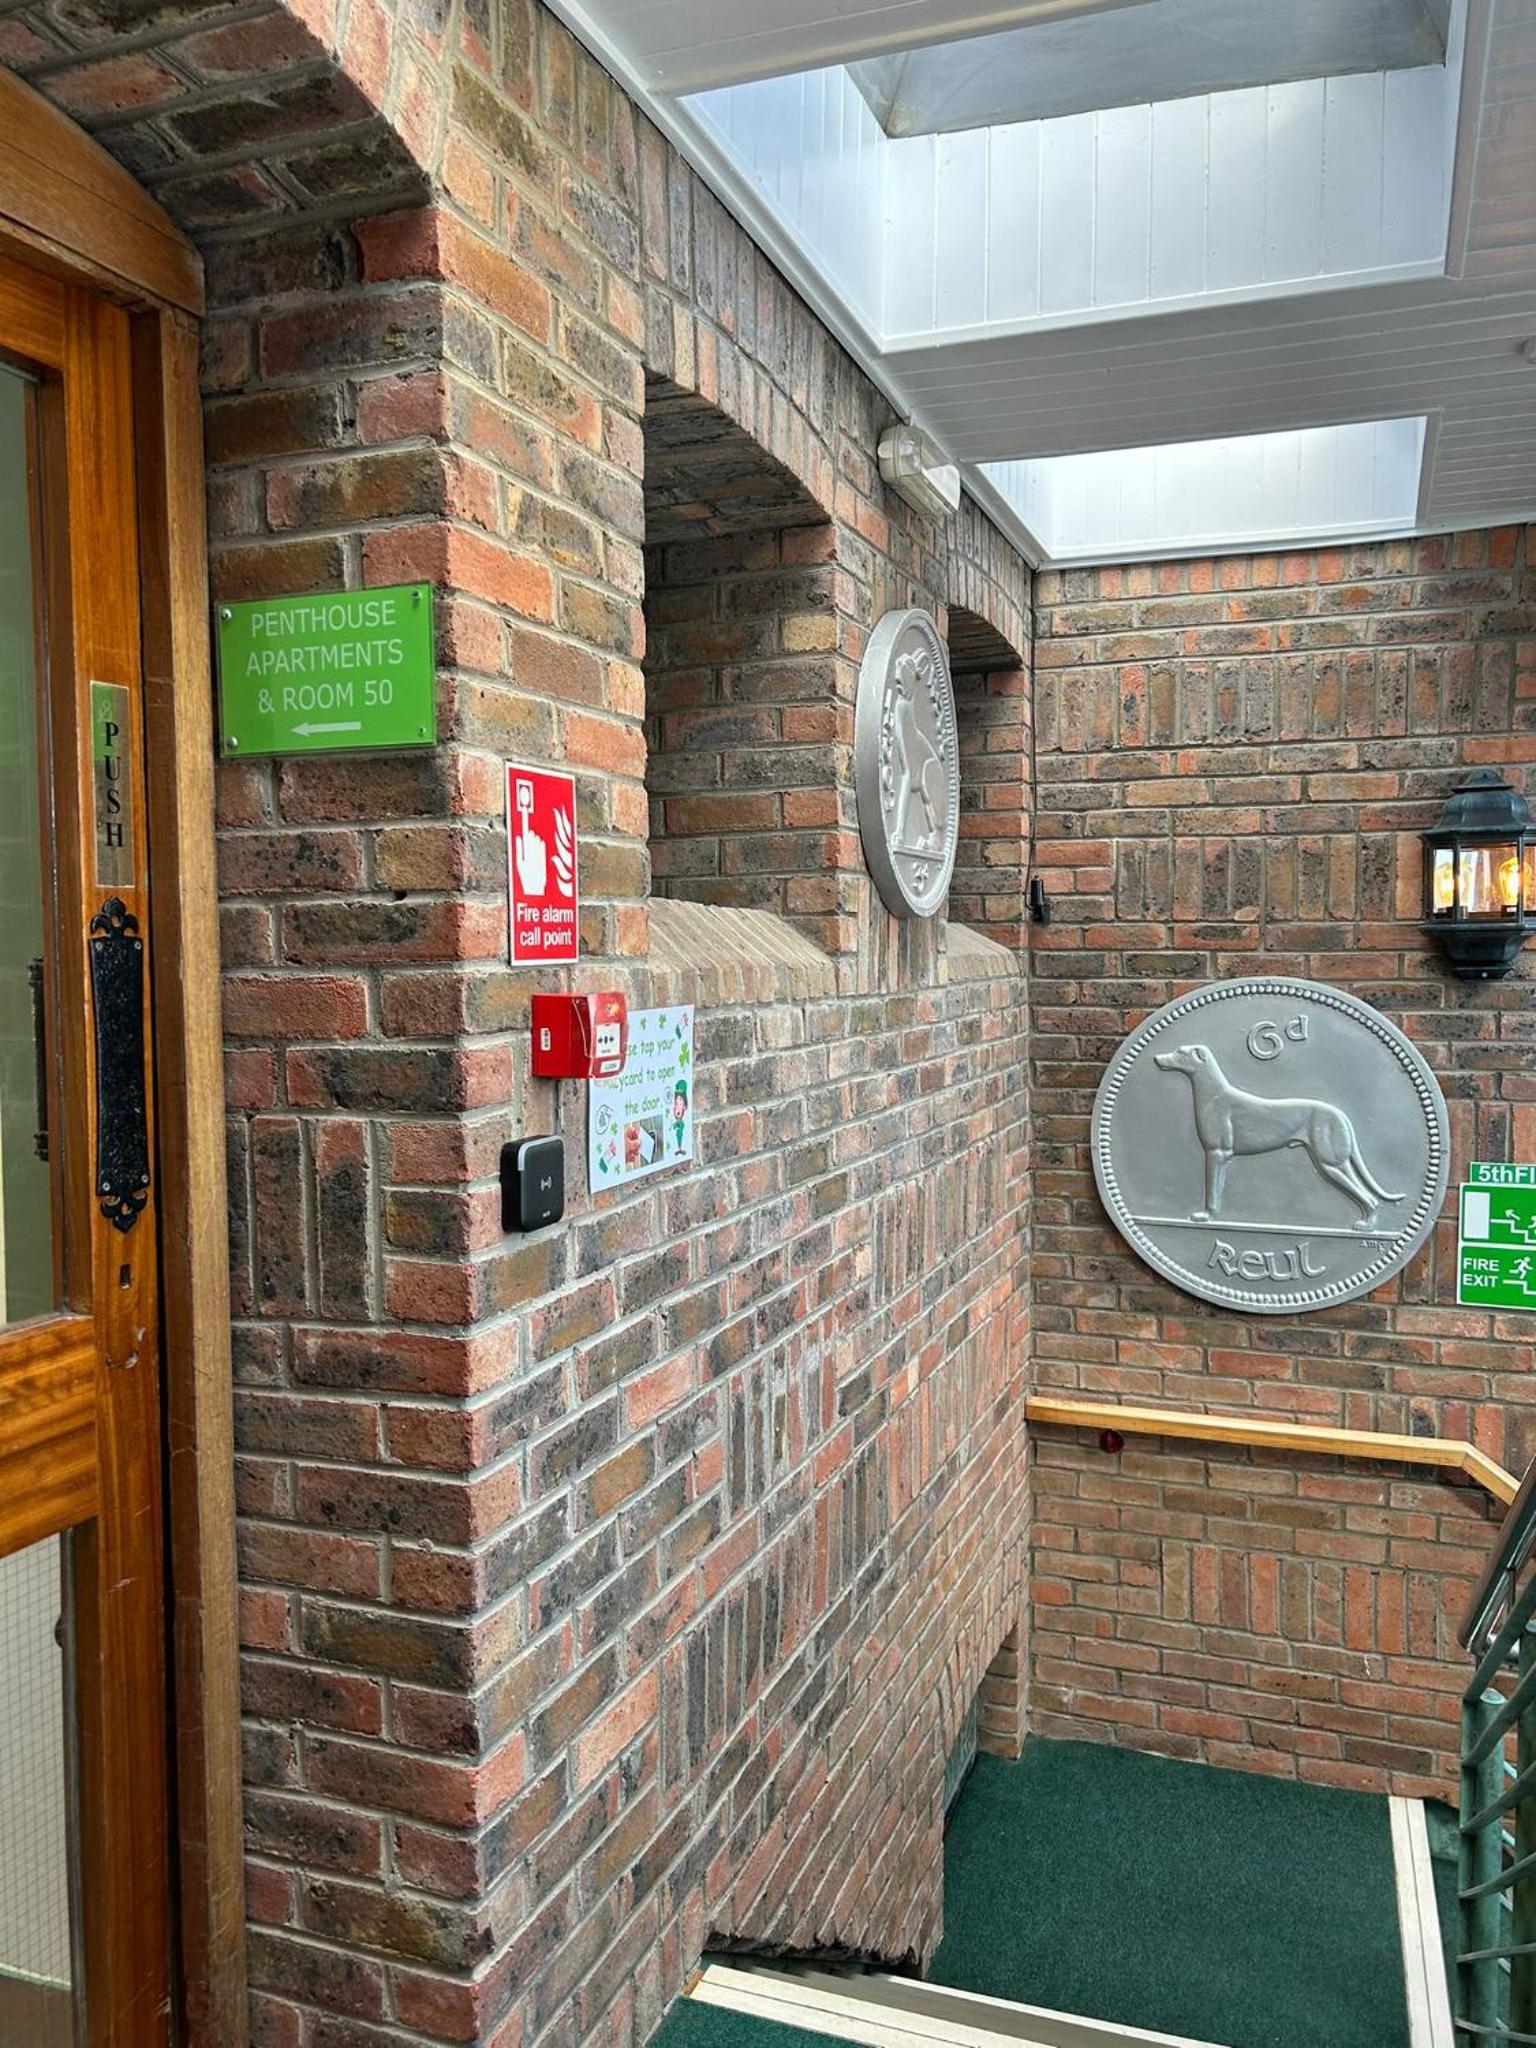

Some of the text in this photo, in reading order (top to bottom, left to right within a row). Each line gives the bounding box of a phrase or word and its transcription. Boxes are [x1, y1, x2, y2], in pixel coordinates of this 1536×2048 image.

[252, 600, 396, 638] PENTHOUSE
[246, 639, 404, 676] APARTMENTS
[258, 679, 393, 714] & ROOM 50
[105, 722, 123, 847] PUSH
[516, 902, 574, 923] Fire alarm
[520, 926, 572, 951] call point
[641, 1039, 654, 1056] tap
[658, 1038, 674, 1056] your
[646, 1067, 656, 1081] to
[658, 1065, 675, 1084] open
[625, 1097, 639, 1115] the
[1463, 1258, 1500, 1272] FIRE
[1463, 1273, 1498, 1288] EXIT
